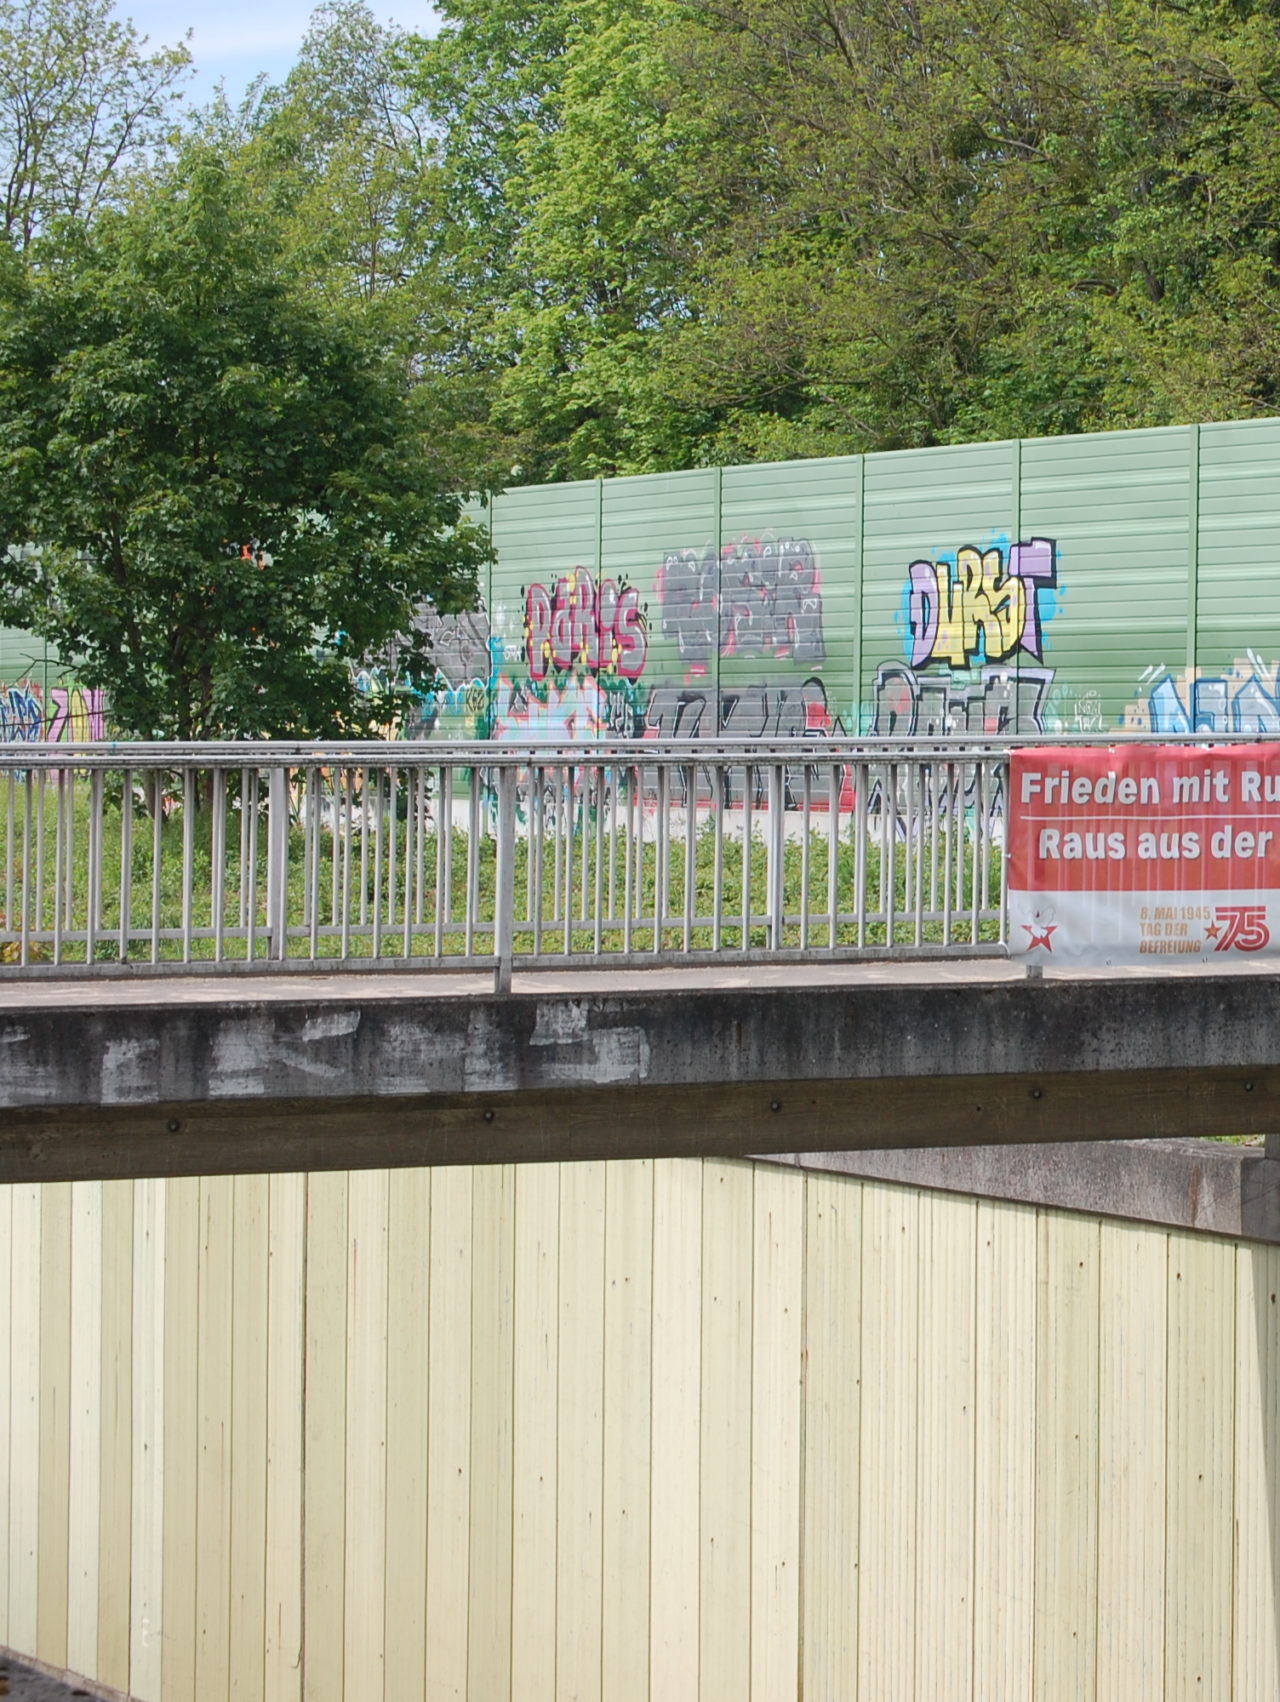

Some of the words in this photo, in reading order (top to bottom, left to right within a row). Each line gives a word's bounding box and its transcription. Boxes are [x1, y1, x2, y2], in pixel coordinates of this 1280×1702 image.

[1020, 770, 1161, 805] Frieden
[1172, 768, 1230, 804] mit
[1038, 828, 1127, 860] Raus
[1137, 831, 1201, 860] aus
[1210, 824, 1273, 859] der
[1154, 906, 1178, 921] MAI
[1180, 905, 1211, 921] 1945
[1140, 922, 1162, 937] TAG
[1165, 922, 1188, 937] DER
[1213, 905, 1271, 952] 75
[1139, 939, 1202, 954] BEFREIUNG
